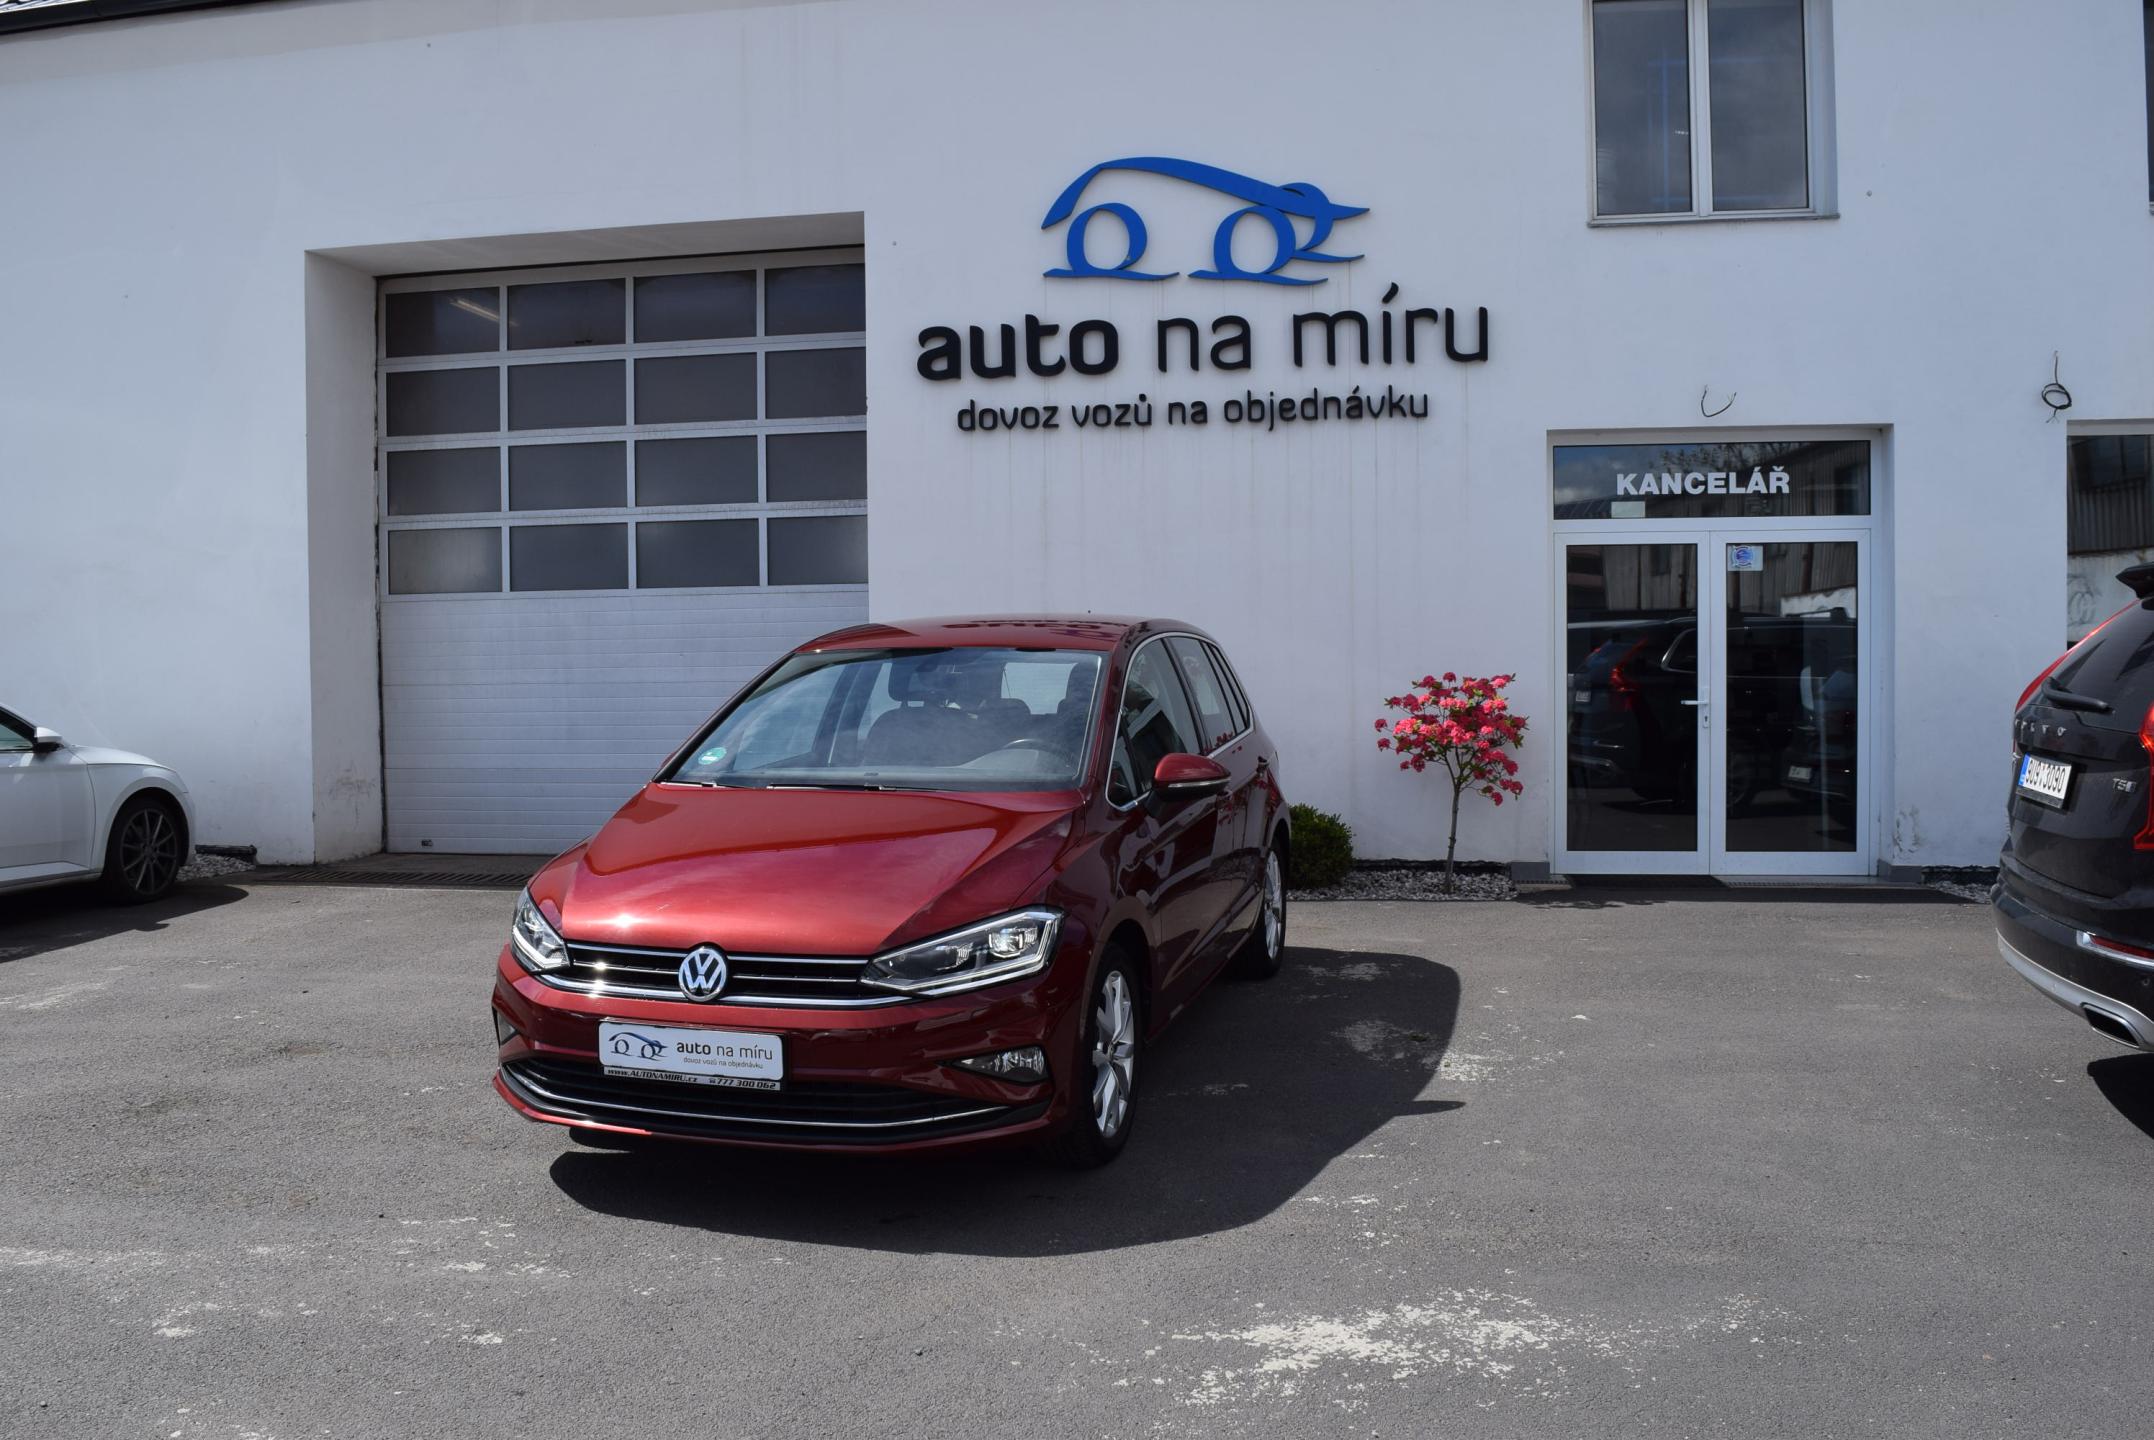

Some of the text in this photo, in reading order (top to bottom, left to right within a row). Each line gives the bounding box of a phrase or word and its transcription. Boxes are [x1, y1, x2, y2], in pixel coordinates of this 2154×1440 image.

[916, 282, 1490, 382] auto na míru
[957, 385, 1429, 433] dovoz vozů na objednávku
[1616, 466, 1790, 496] KANCELÁŘ
[676, 1042, 773, 1060] auto na míru
[717, 1078, 735, 1086] 777
[735, 1080, 755, 1088] 300
[756, 1081, 776, 1089] 062
